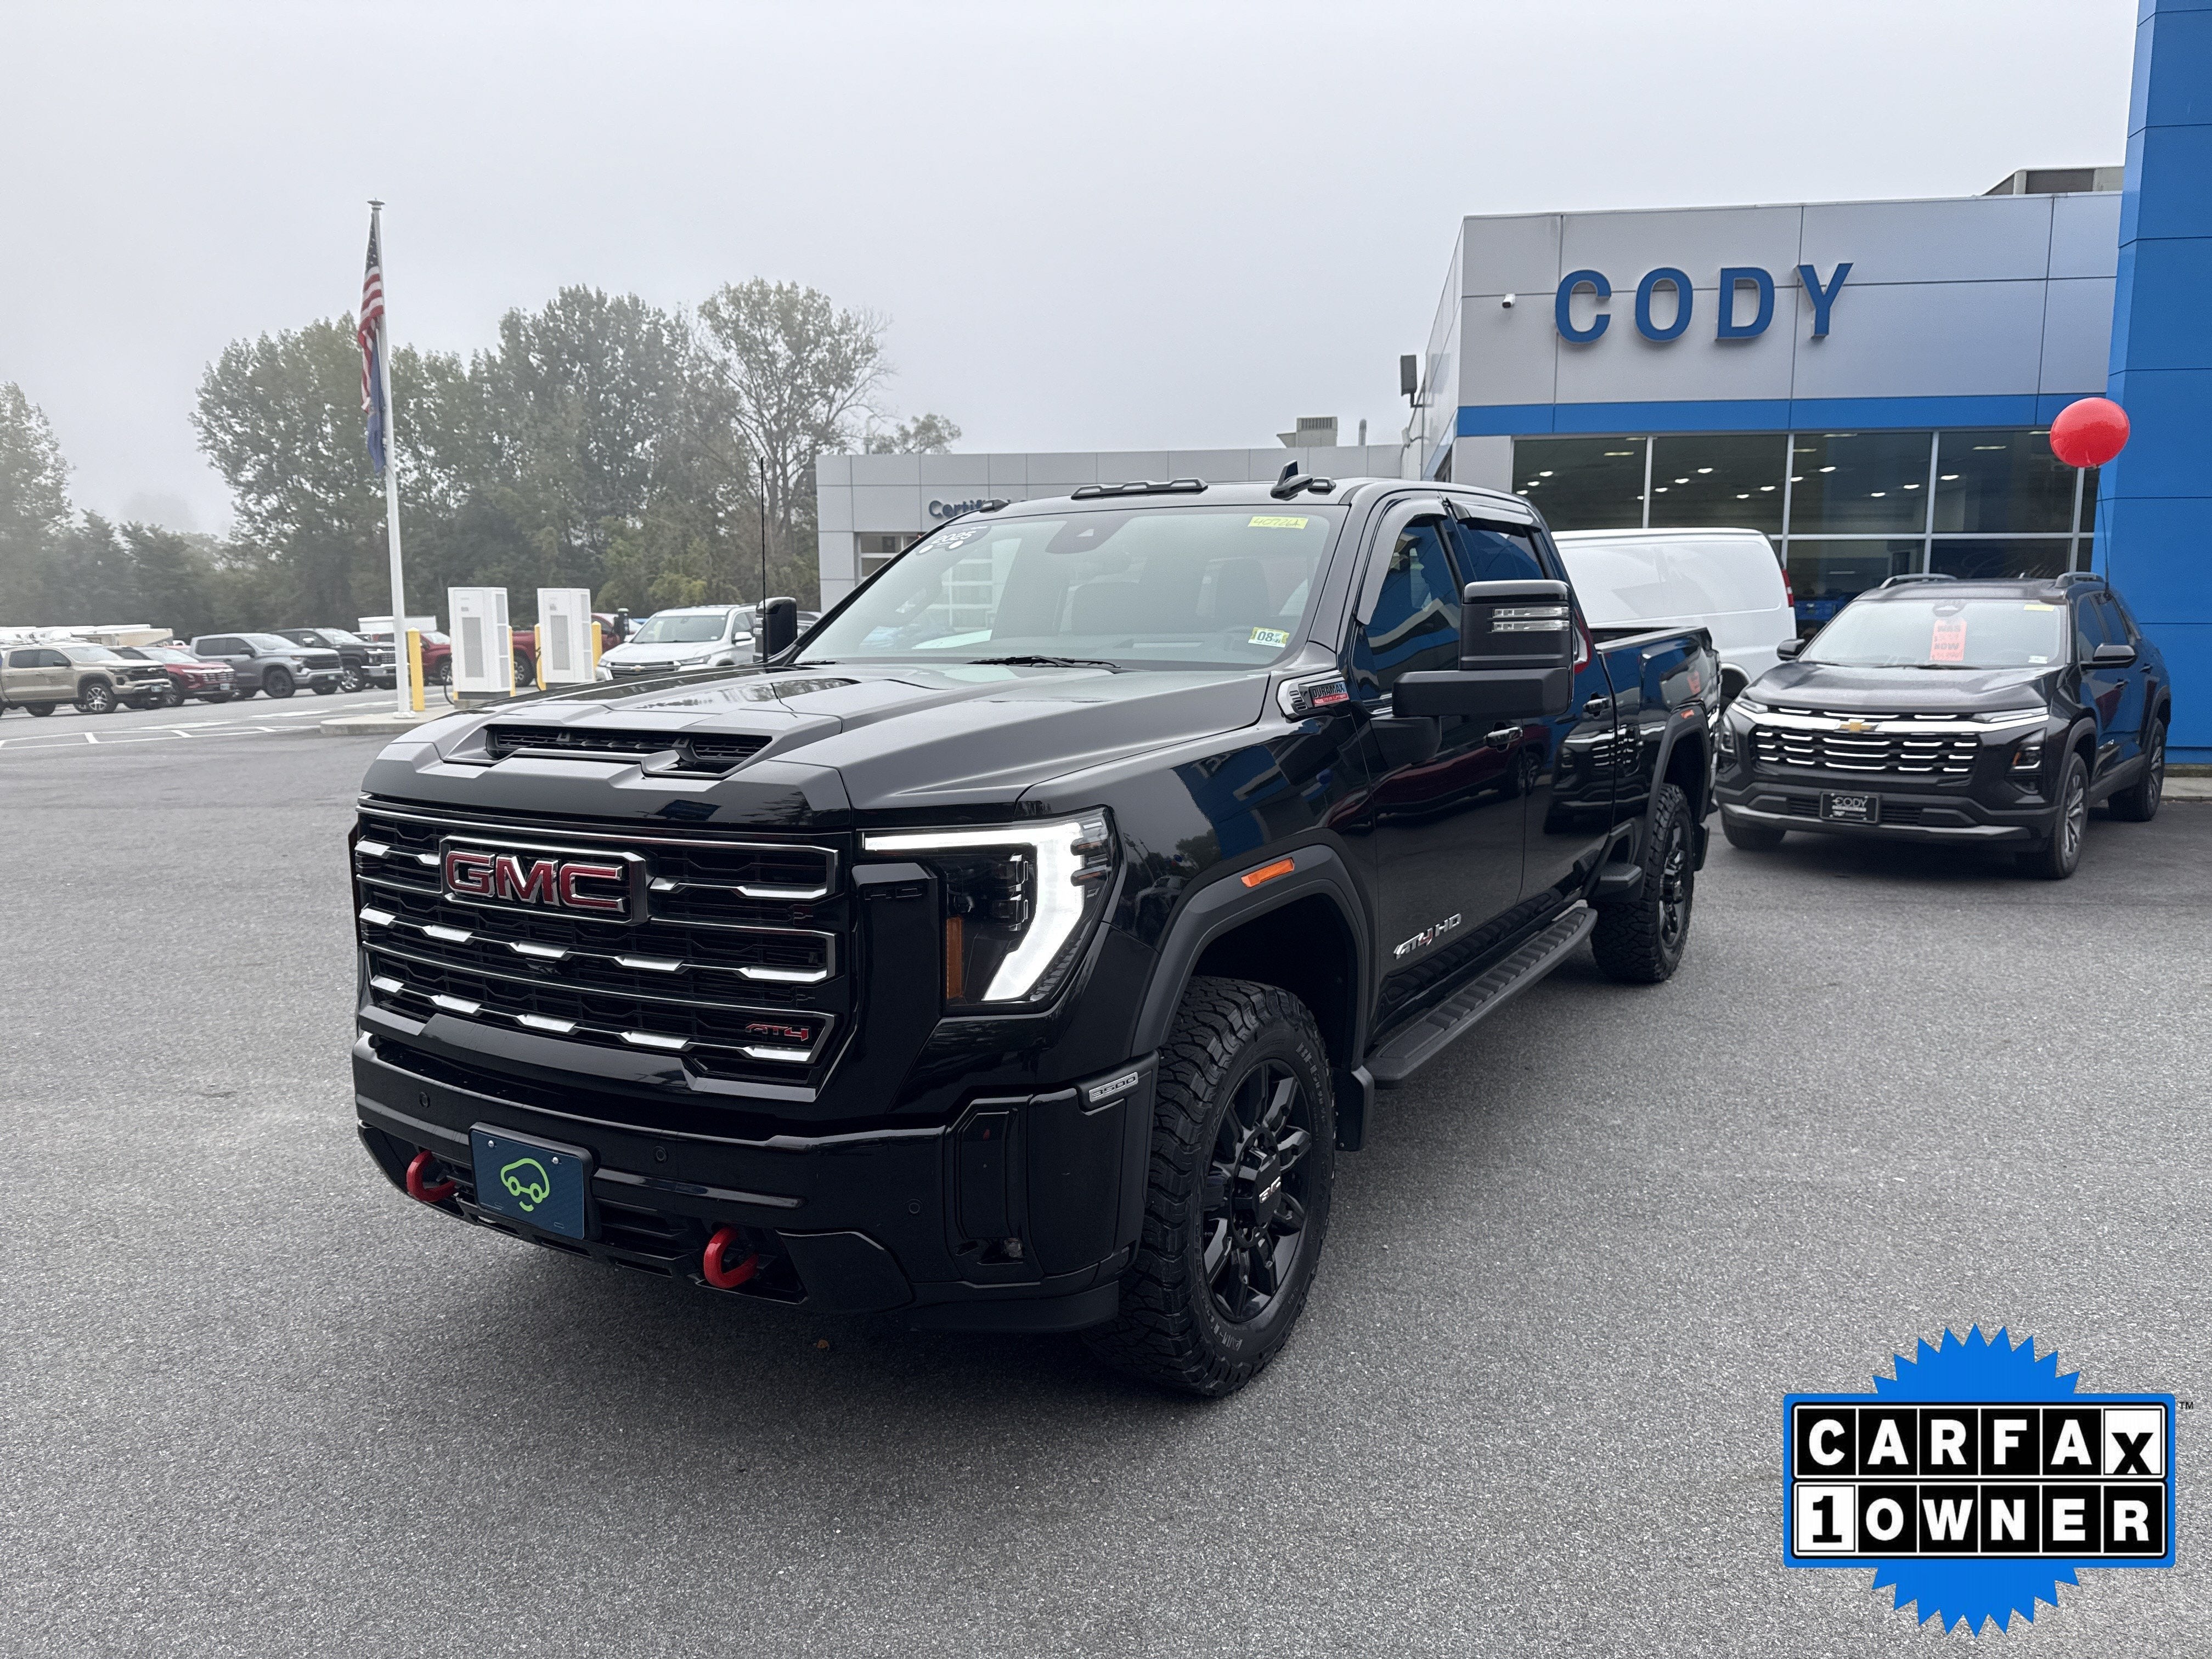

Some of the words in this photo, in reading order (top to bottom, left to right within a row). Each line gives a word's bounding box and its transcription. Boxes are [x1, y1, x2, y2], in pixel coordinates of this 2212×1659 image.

[1554, 262, 1854, 344] CODY
[931, 530, 977, 544] 2025
[1257, 631, 1274, 642] 08
[1934, 642, 1960, 650] NOW
[1312, 682, 1346, 697] DURAMAX
[1835, 796, 1868, 808] CODY
[445, 850, 625, 913] GMC
[1393, 927, 1434, 960] AT4
[1435, 913, 1462, 937] HD
[745, 1023, 809, 1042] AT4
[1092, 1076, 1136, 1098] 3500
